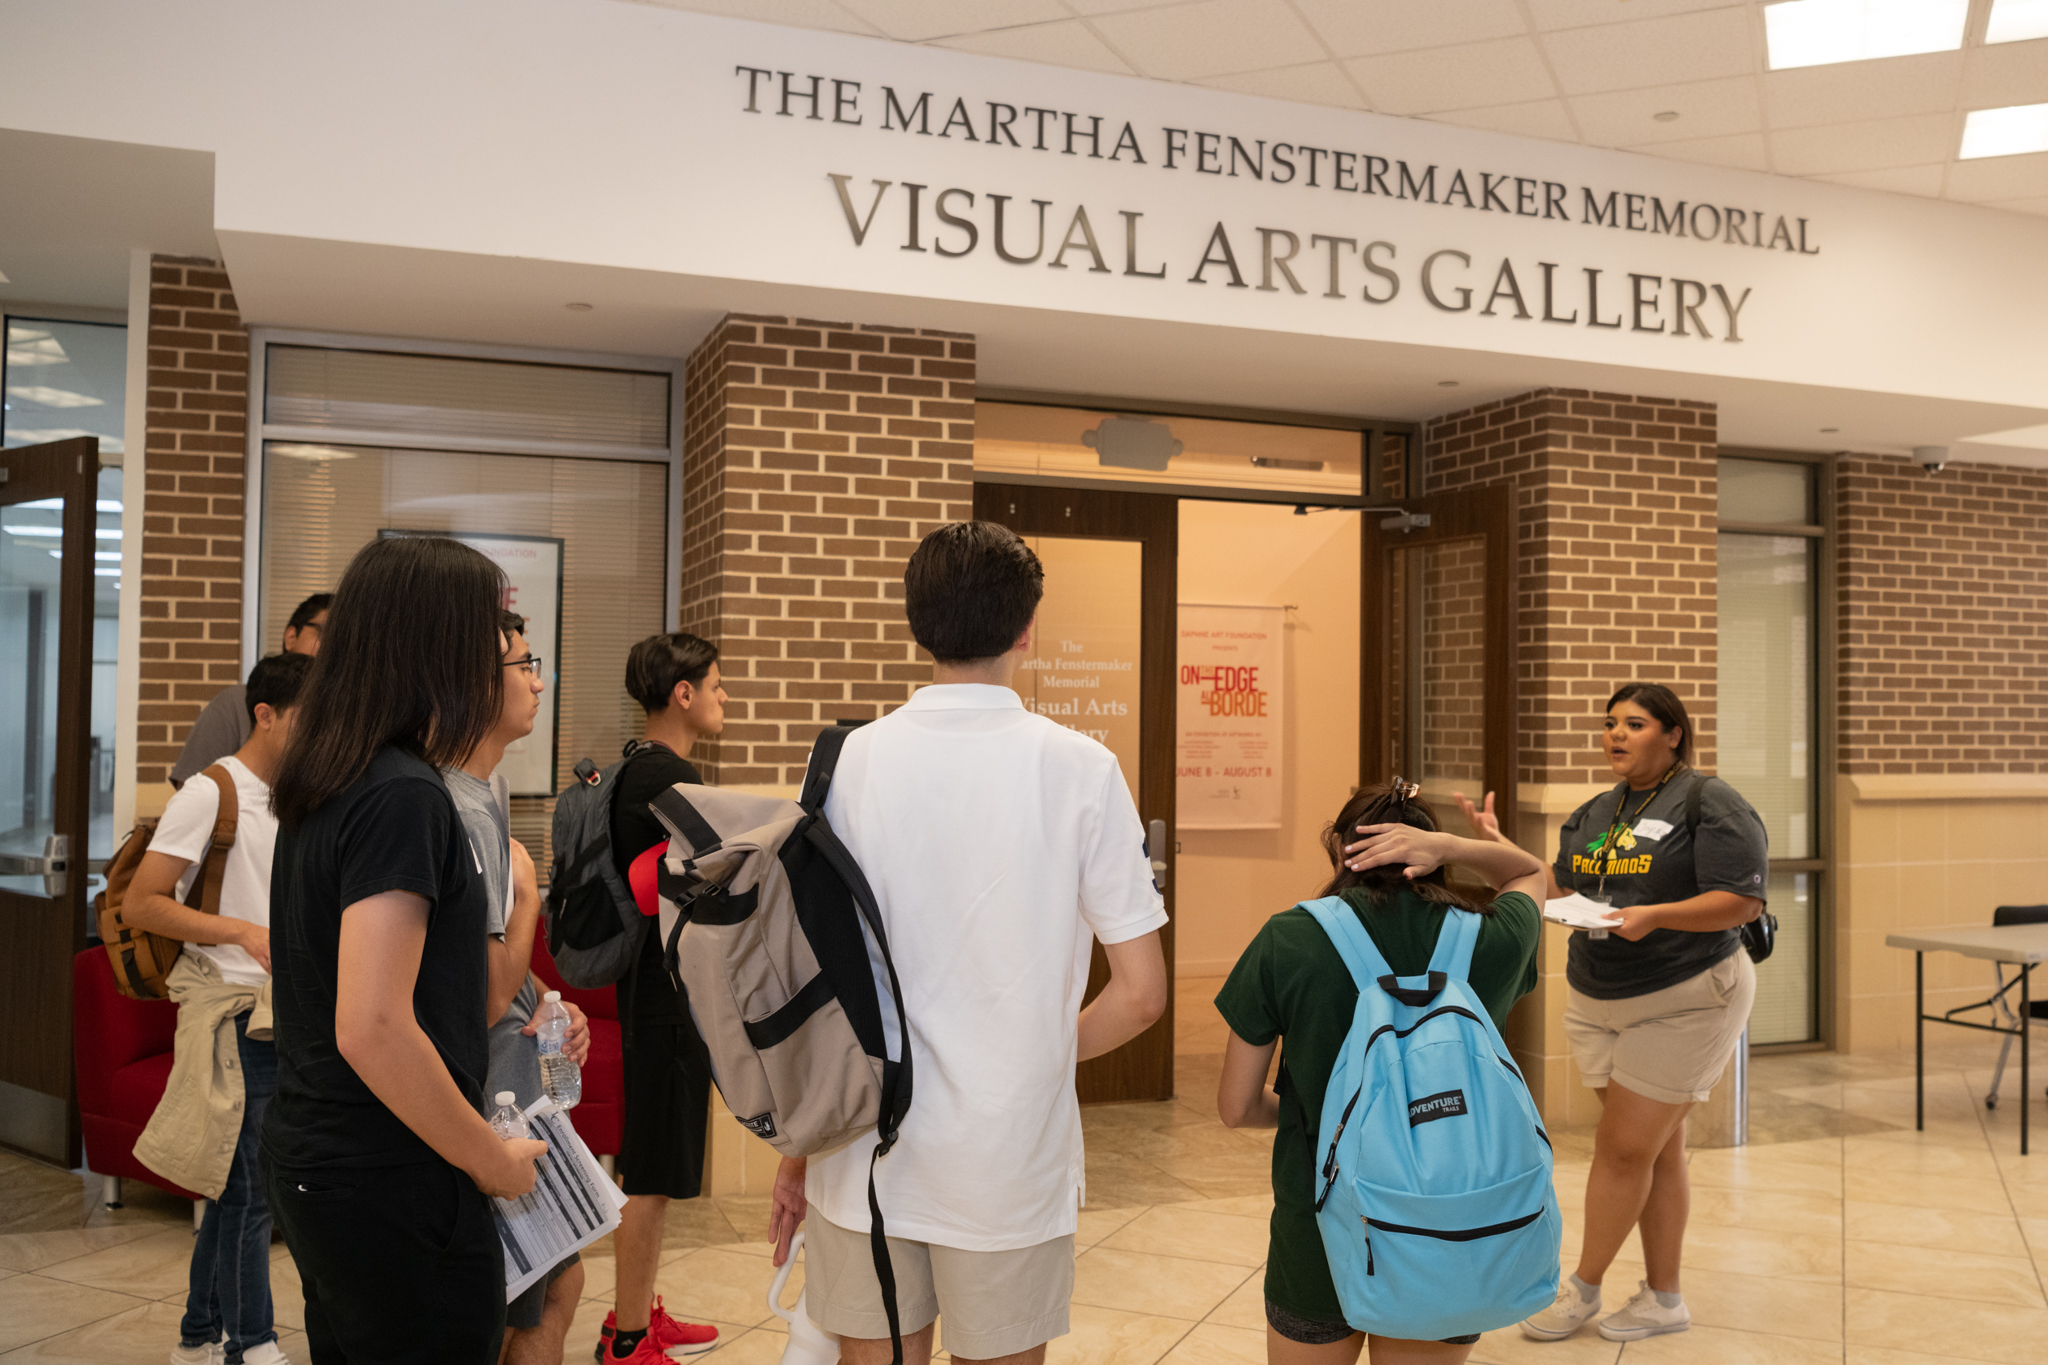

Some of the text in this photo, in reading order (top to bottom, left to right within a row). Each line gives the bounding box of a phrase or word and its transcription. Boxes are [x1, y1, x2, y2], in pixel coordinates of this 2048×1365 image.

[736, 65, 1821, 255] THE MARTHA FENSTERMAKER MEMORIAL
[827, 172, 1753, 343] VISUAL ARTS GALLERY
[1211, 631, 1224, 639] ART
[1060, 640, 1084, 653] The
[1020, 657, 1133, 671] artha Fenstermaker
[1043, 675, 1100, 689] Memorial
[1181, 665, 1200, 685] ON
[1214, 666, 1259, 692] EDGE
[1085, 698, 1128, 716] Arts
[1210, 691, 1268, 717] BORDE
[1223, 767, 1263, 778] AUGUST
[1442, 1105, 1459, 1113] TRAILS
[556, 1125, 577, 1156] Enrollment
[574, 1154, 591, 1183] Screening
[589, 1182, 600, 1199] Form
